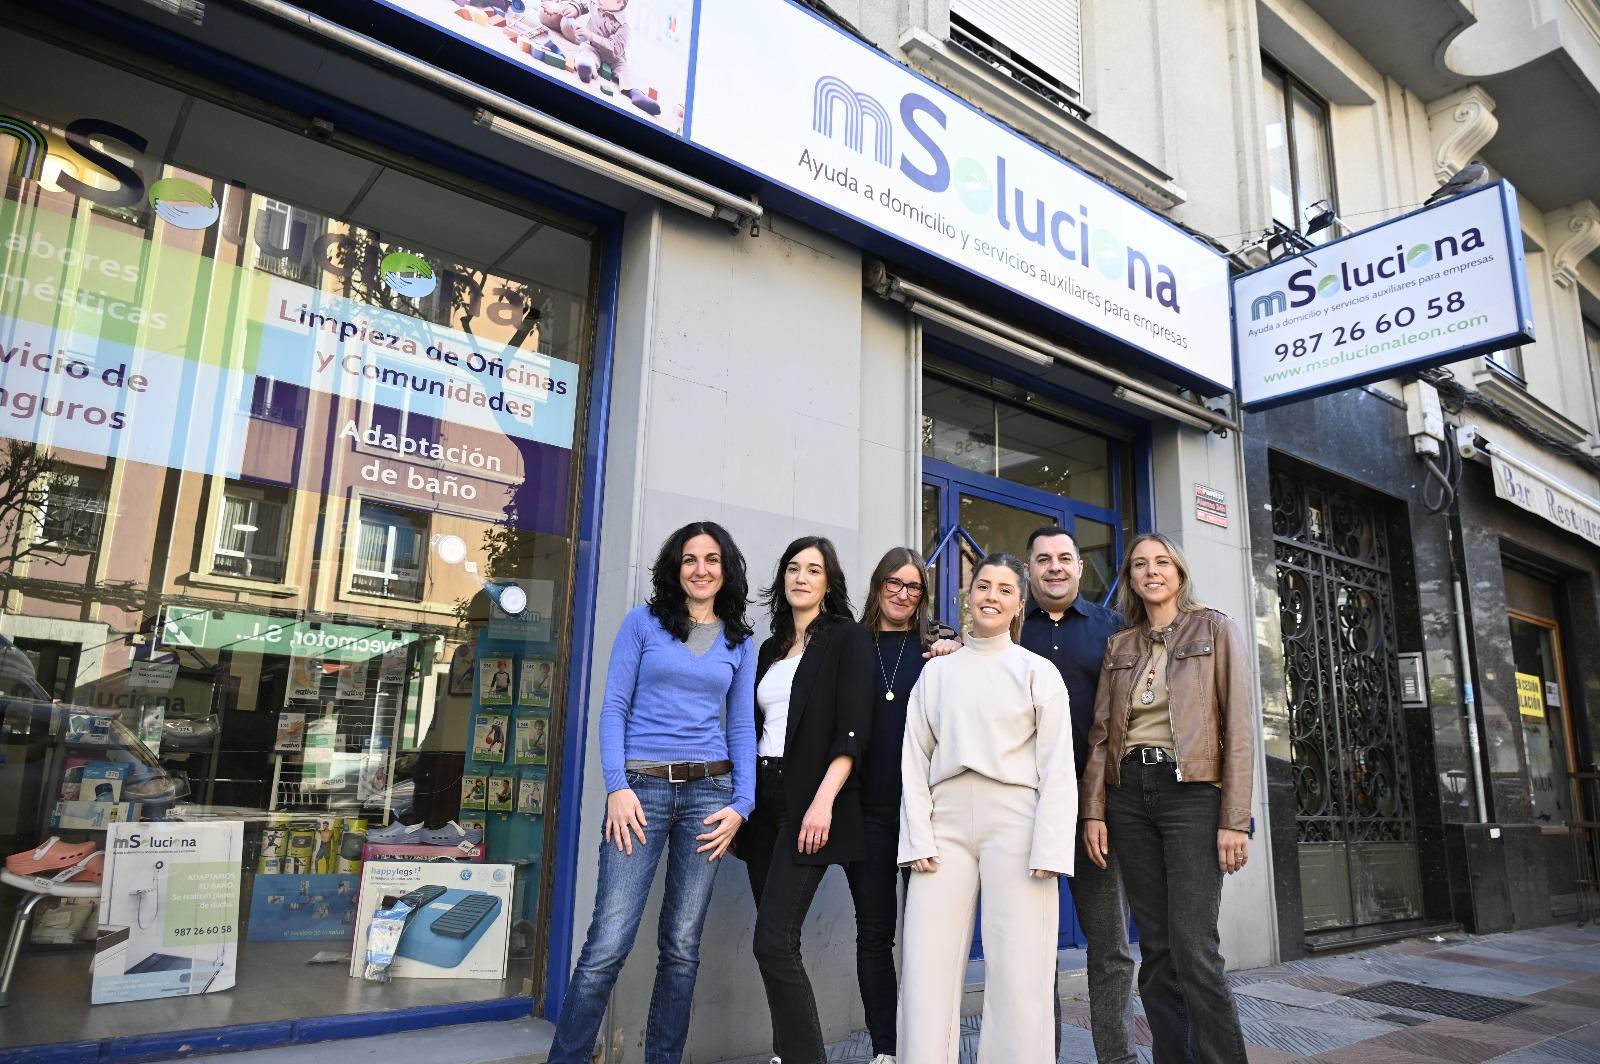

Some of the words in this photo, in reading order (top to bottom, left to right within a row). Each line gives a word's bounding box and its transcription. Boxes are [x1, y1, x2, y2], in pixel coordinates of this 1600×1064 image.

[0, 230, 140, 283] abores
[798, 149, 859, 193] Ayuda
[864, 184, 874, 201] a
[880, 188, 956, 239] domicilio
[961, 230, 970, 250] y
[974, 237, 1036, 278] servicios
[1040, 268, 1101, 308] auxiliares
[1104, 298, 1130, 321] para
[1134, 313, 1188, 349] empresas
[1248, 324, 1274, 338] Ayuda
[1276, 320, 1281, 329] a
[1282, 309, 1322, 327] domicilio
[1323, 307, 1329, 316] y
[1331, 293, 1370, 312] servicios
[1372, 279, 1416, 299] auxiliares
[1418, 271, 1441, 287] para
[1443, 254, 1494, 277] empresas
[279, 299, 417, 356] Limpieza
[425, 341, 459, 367] de
[466, 352, 568, 395] Oficinas
[1263, 314, 1488, 384] www.msolucionaleon.com
[1274, 332, 1323, 362] 987
[1332, 321, 1366, 347] 26
[1375, 306, 1416, 334] 60
[1427, 291, 1465, 319] 58
[101, 363, 149, 393] de
[316, 350, 336, 374] y
[342, 354, 533, 419] Comunidades
[339, 419, 502, 473] Adaptación
[361, 459, 399, 485] de
[407, 466, 478, 500] baño
[1501, 463, 1531, 507] Bar
[371, 866, 413, 877] happylegs
[174, 928, 191, 937] 987
[194, 927, 204, 936] 26
[207, 926, 219, 935] 60
[221, 925, 232, 934] 58
